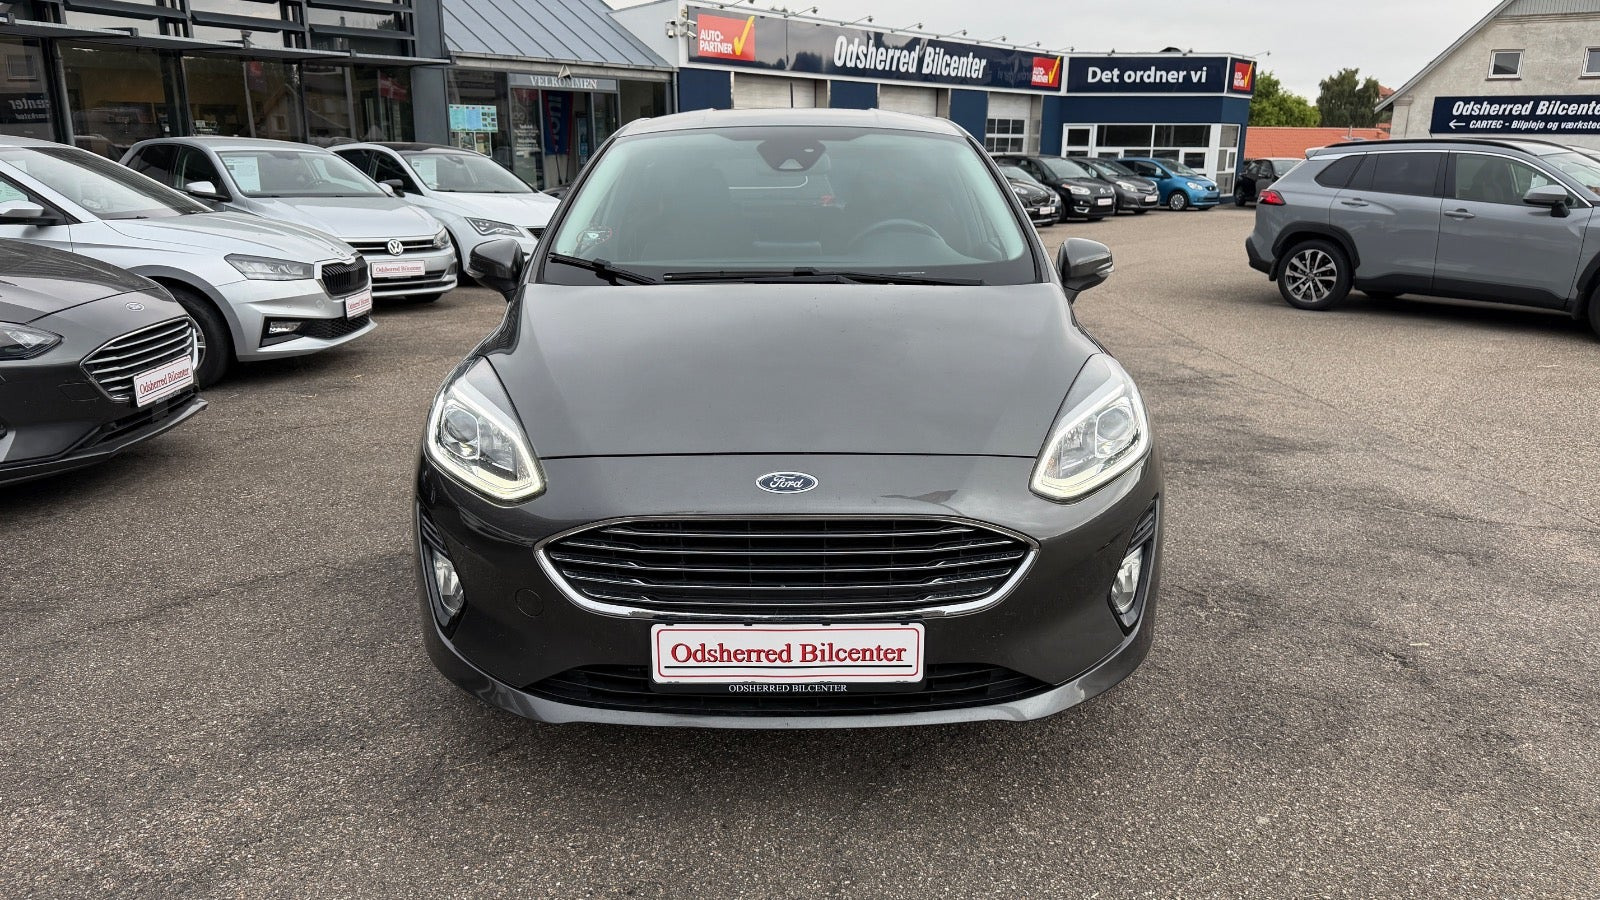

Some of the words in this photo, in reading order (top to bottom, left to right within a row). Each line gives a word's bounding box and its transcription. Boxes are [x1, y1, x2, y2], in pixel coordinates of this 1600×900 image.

[700, 29, 724, 41] AUTO-
[700, 41, 733, 54] PARTNER
[833, 35, 920, 73] Odsherred
[921, 46, 987, 79] Bilcenter
[1087, 66, 1120, 83] Det
[1123, 65, 1187, 83] ordner
[1190, 66, 1207, 83] vi
[530, 75, 598, 89] VELKOMMEN
[1452, 100, 1534, 116] Odsherred
[1469, 120, 1503, 129] CARTEC
[1511, 119, 1545, 131] Bilpleje
[1546, 121, 1559, 131] og
[769, 475, 804, 488] Ford
[670, 642, 793, 663] Odsherred
[799, 642, 906, 663] Bilcenter
[728, 684, 790, 693] ODSHERRED
[791, 684, 848, 693] BILCENTER
